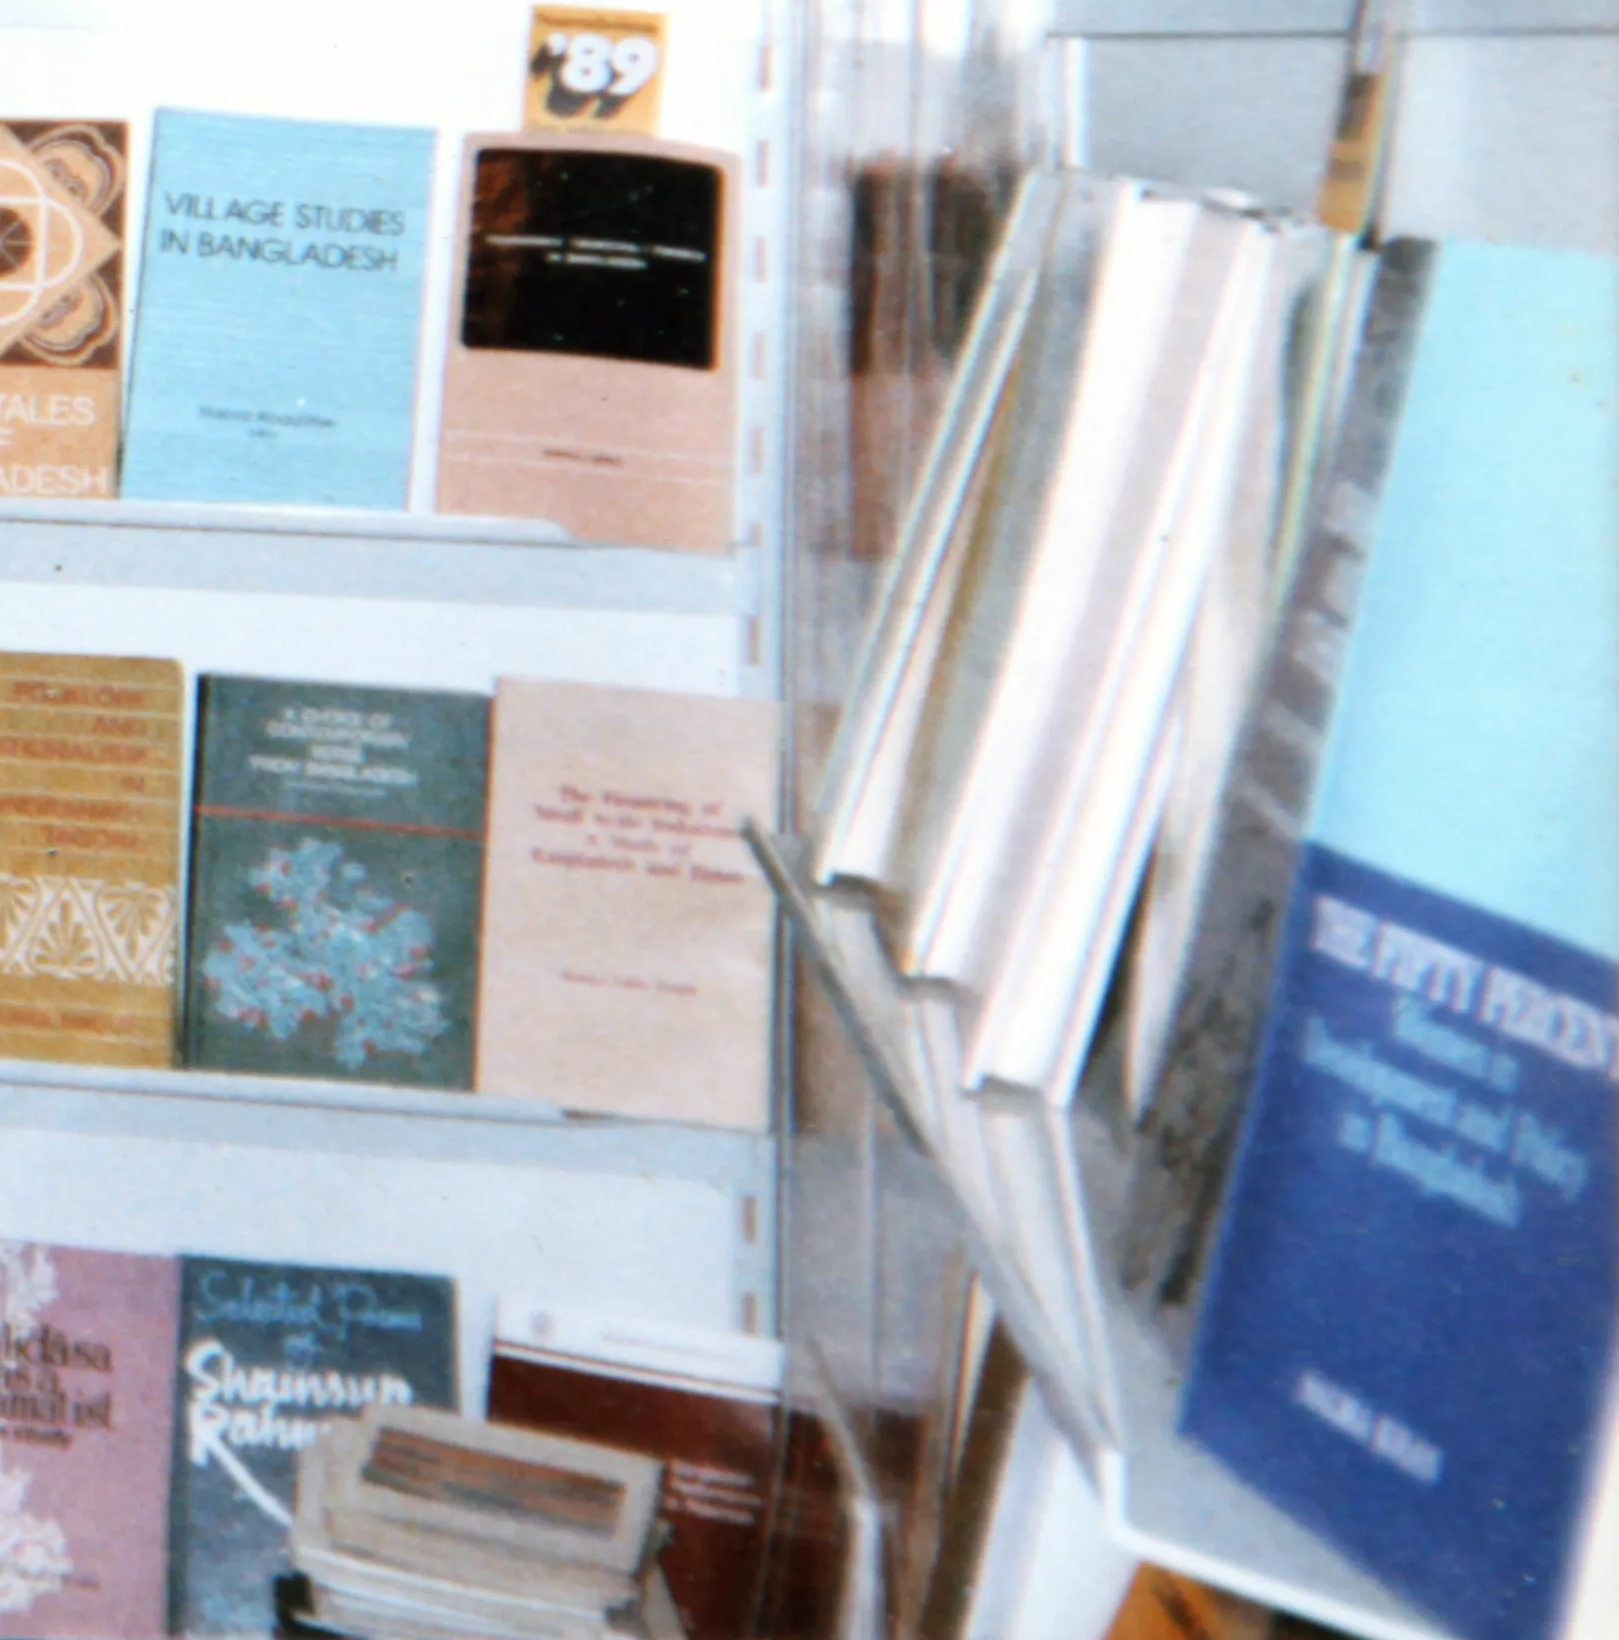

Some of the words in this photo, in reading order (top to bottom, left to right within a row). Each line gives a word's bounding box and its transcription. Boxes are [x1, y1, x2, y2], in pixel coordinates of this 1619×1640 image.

[547, 31, 659, 95] '89
[162, 189, 286, 228] VILLAGE
[296, 203, 407, 238] STUDIES
[159, 228, 191, 257] IN
[197, 230, 399, 274] BANGLADESH
[1373, 921, 1484, 1016] FIFTY
